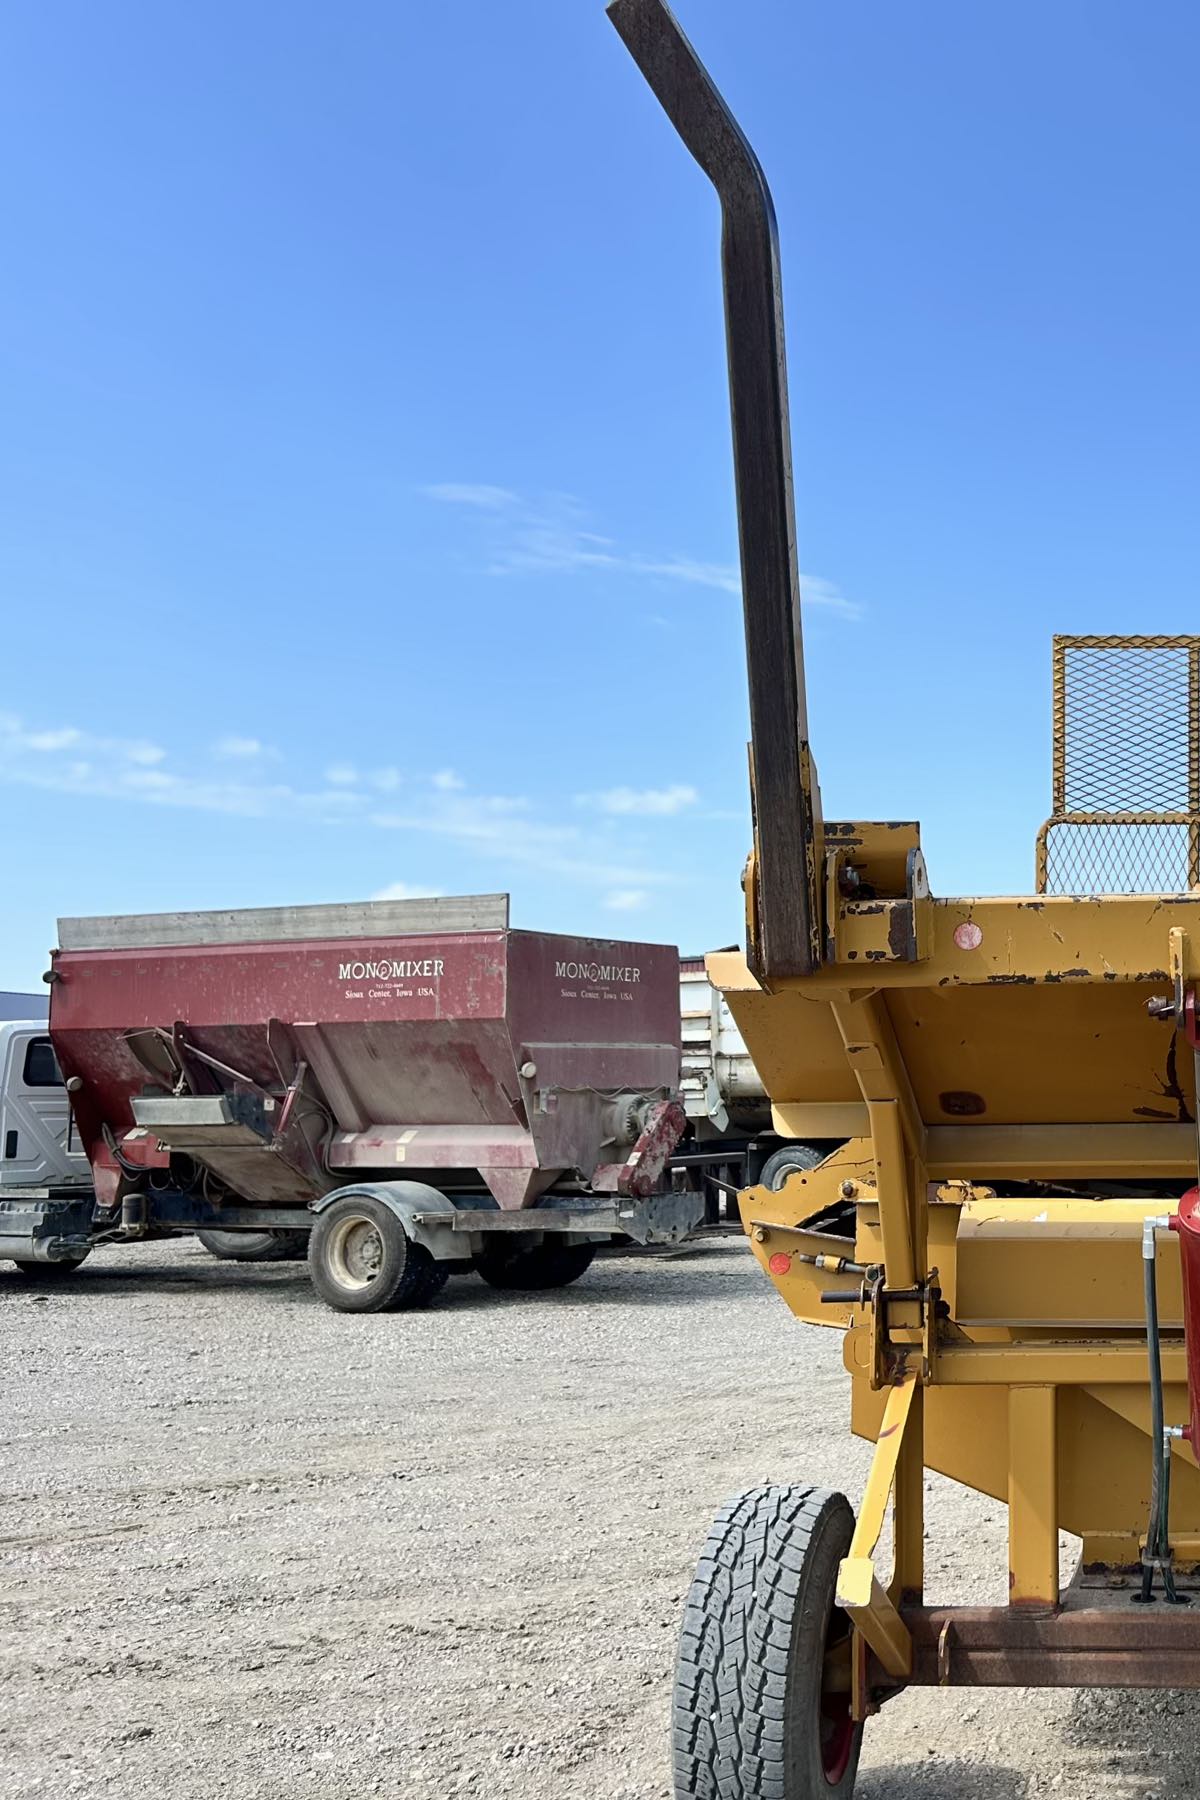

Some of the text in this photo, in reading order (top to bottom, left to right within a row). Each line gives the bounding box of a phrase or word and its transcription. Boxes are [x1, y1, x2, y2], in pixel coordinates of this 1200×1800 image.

[338, 960, 444, 980] MONOMIXER
[555, 961, 640, 982] MONOMIXER
[345, 990, 364, 999] Sioux
[396, 988, 413, 997] Iowa
[418, 987, 434, 996] USA
[620, 992, 634, 1001] USA
